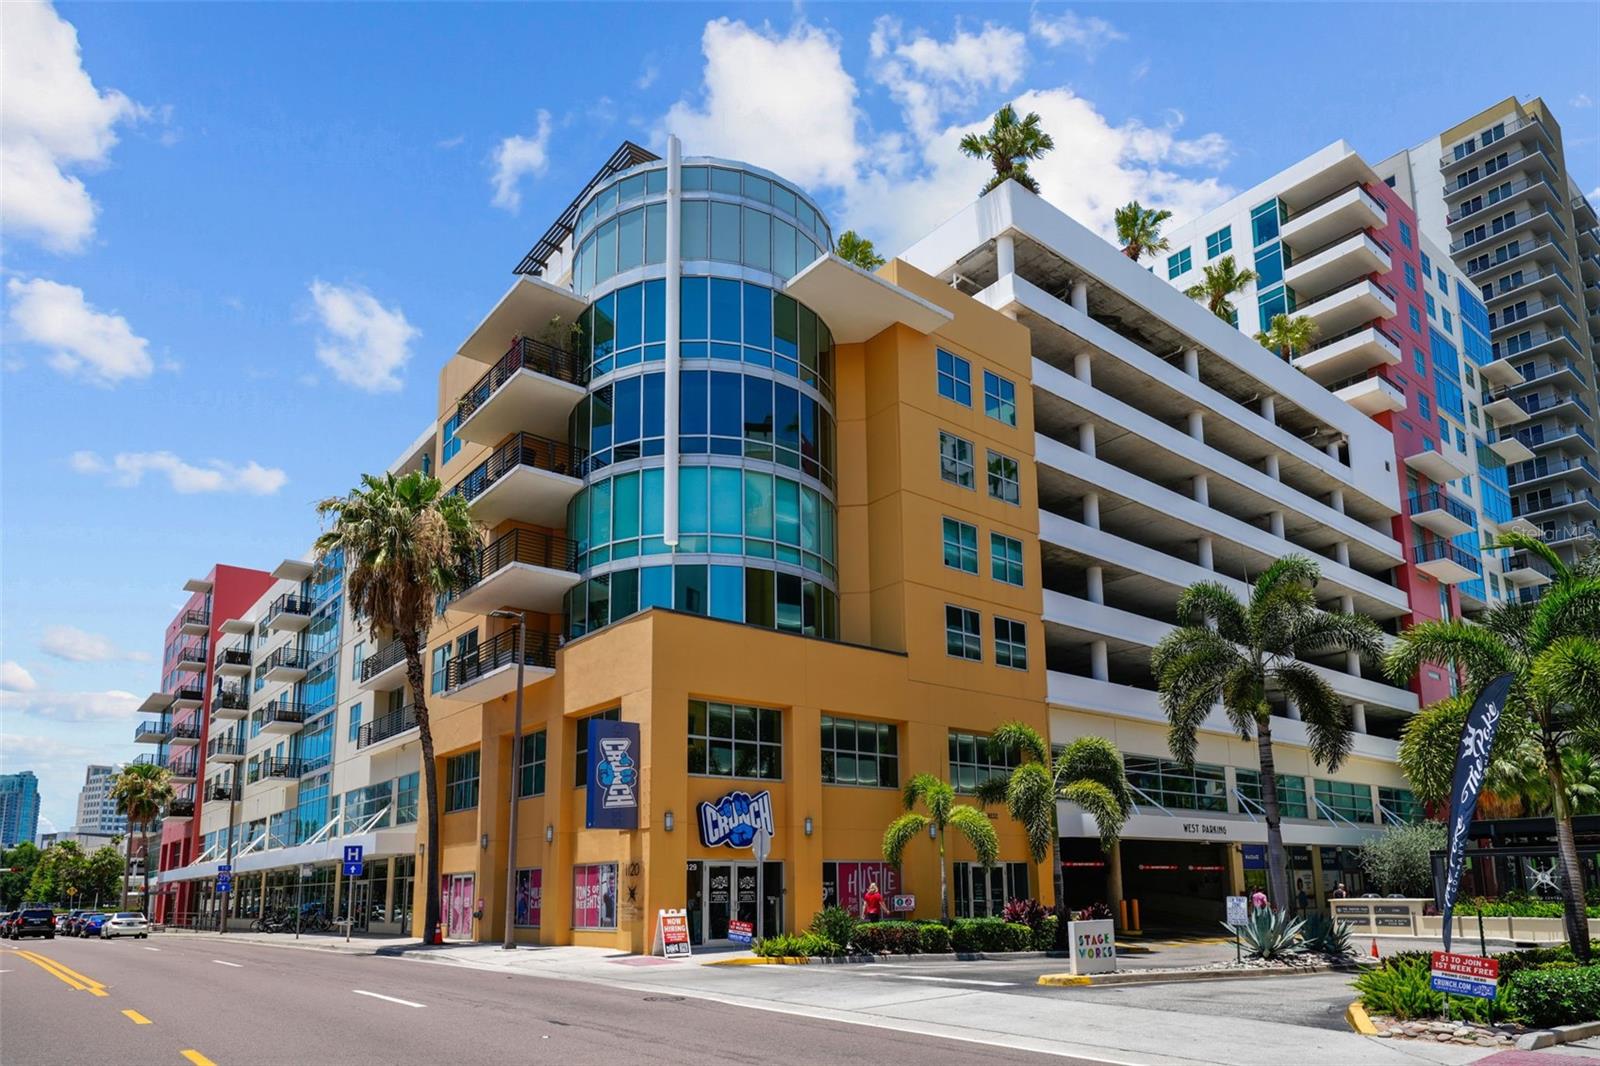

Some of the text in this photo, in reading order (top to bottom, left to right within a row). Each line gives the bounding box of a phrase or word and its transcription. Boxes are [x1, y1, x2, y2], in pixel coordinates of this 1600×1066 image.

[602, 740, 635, 807] CRUNCH
[704, 794, 773, 843] CRUNCH
[1183, 824, 1227, 835] WEST PARKING
[348, 848, 359, 861] H
[848, 866, 896, 896] HUSTLE
[576, 886, 591, 898] TONS
[576, 895, 600, 909] WEIGHTS
[1078, 933, 1109, 946] STAGE
[1078, 947, 1113, 959] WORKS
[1451, 956, 1461, 964] TO
[1463, 959, 1482, 967] JOIN
[1435, 961, 1494, 976] 1ST WEEK FREE
[1433, 978, 1472, 991] CRUNCH.COM
